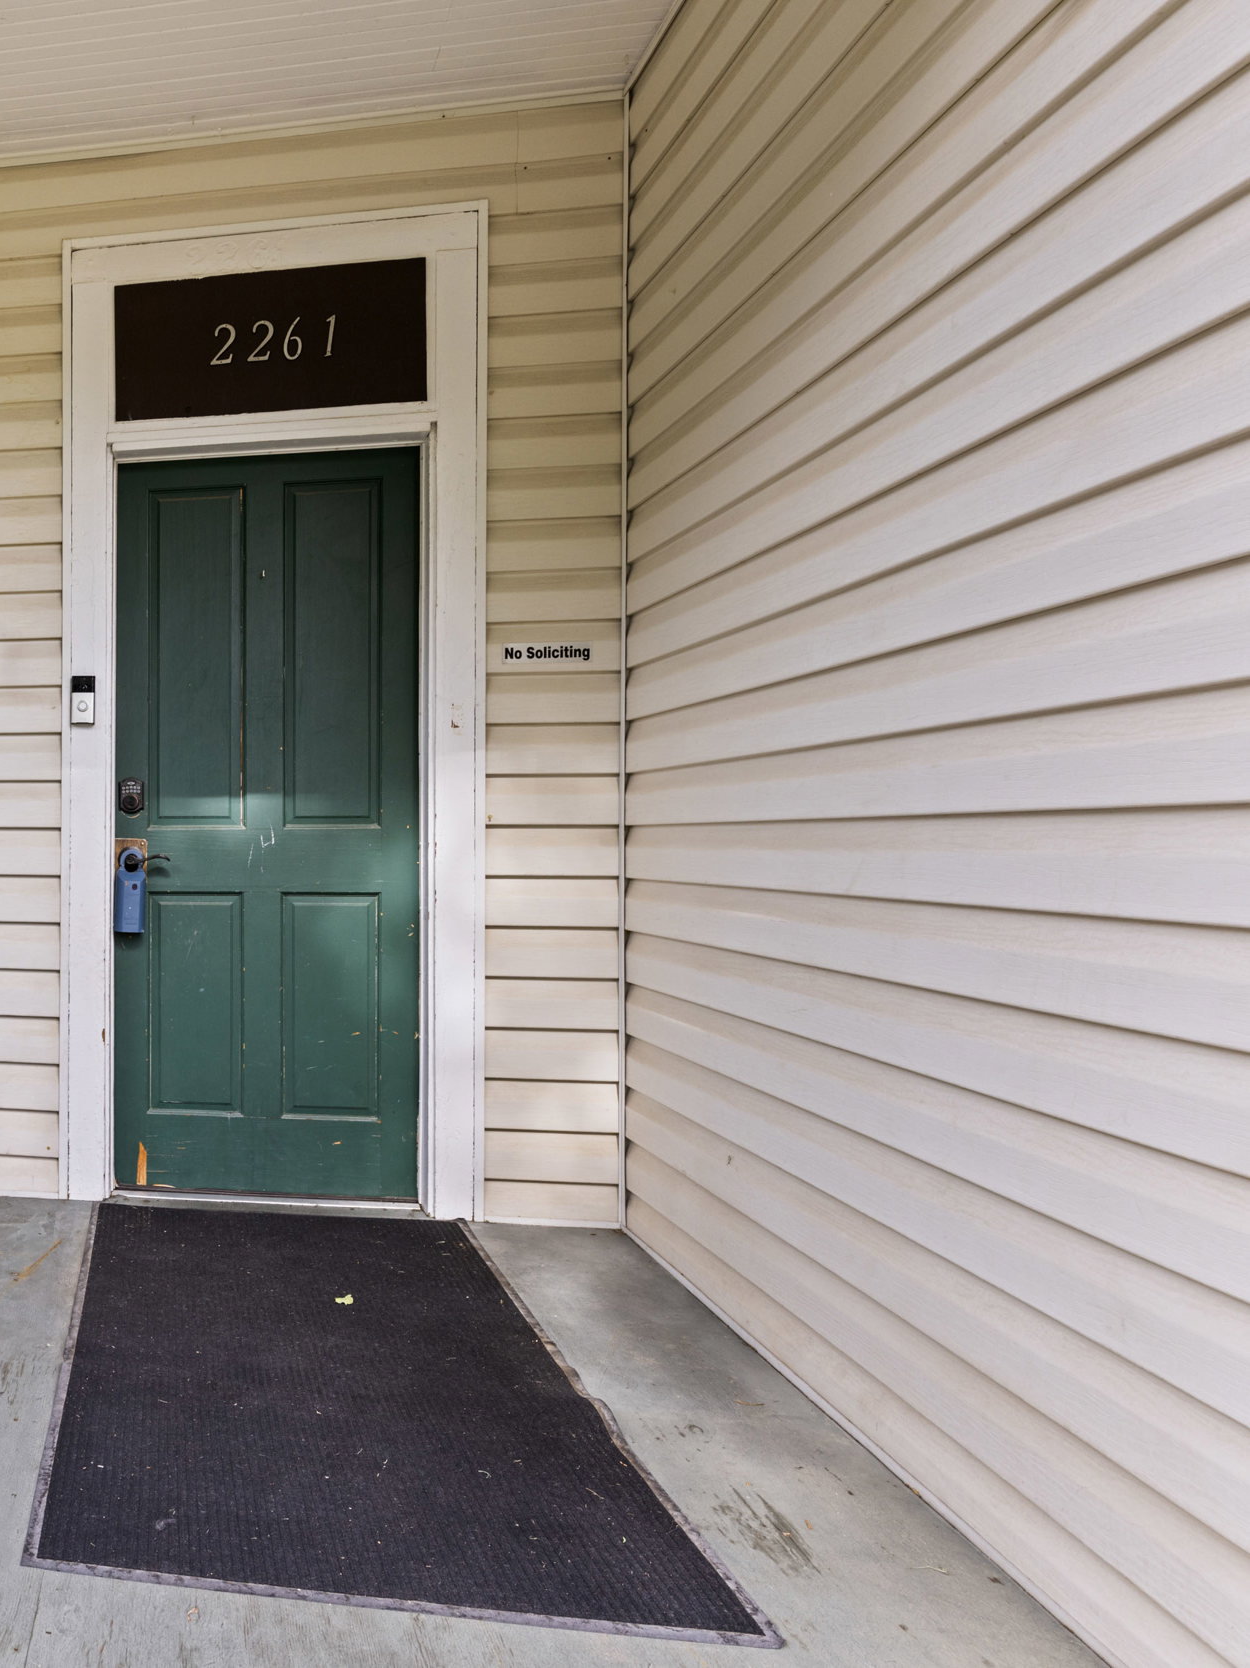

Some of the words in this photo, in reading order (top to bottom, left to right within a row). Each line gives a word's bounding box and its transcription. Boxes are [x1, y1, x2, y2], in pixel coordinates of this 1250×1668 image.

[210, 314, 336, 366] 2261
[504, 647, 523, 660] No
[526, 645, 591, 661] Soliciting
